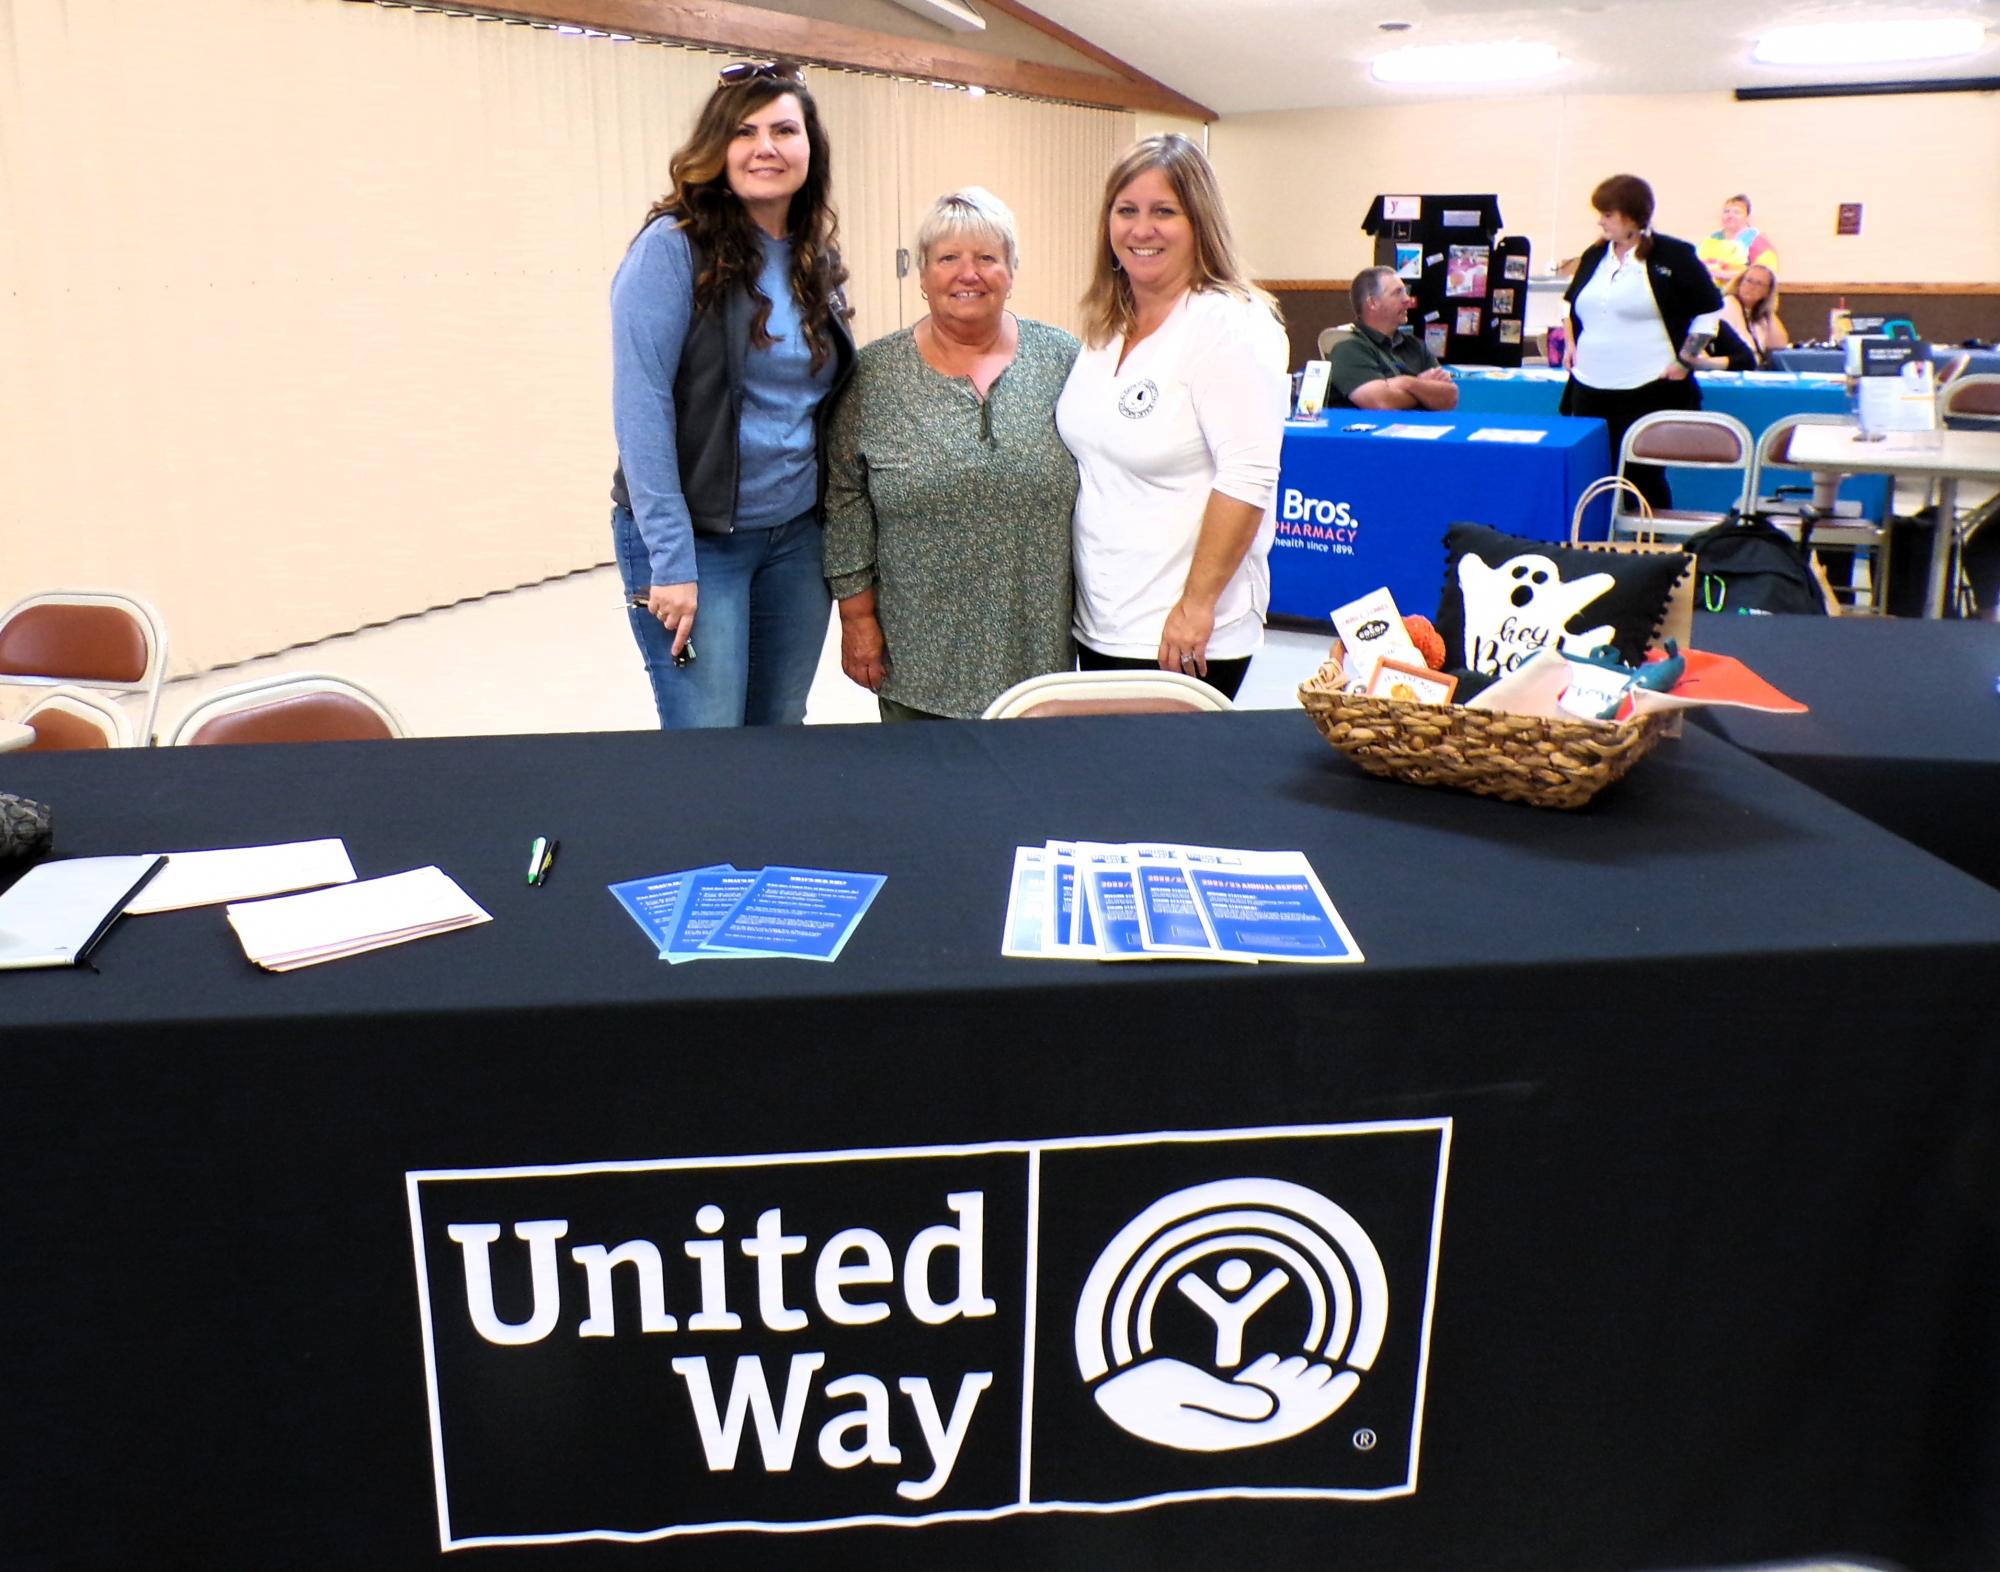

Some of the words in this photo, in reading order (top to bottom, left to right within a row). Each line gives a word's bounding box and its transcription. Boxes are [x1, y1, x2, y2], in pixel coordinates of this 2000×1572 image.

[1283, 488, 1358, 528] Bros.
[1274, 521, 1357, 543] PHARMACY
[1275, 537, 1304, 549] health
[1307, 540, 1329, 553] since
[1332, 544, 1355, 556] 1899.
[1497, 616, 1549, 650] hey
[446, 1190, 997, 1346] United
[672, 1351, 993, 1500] Way
